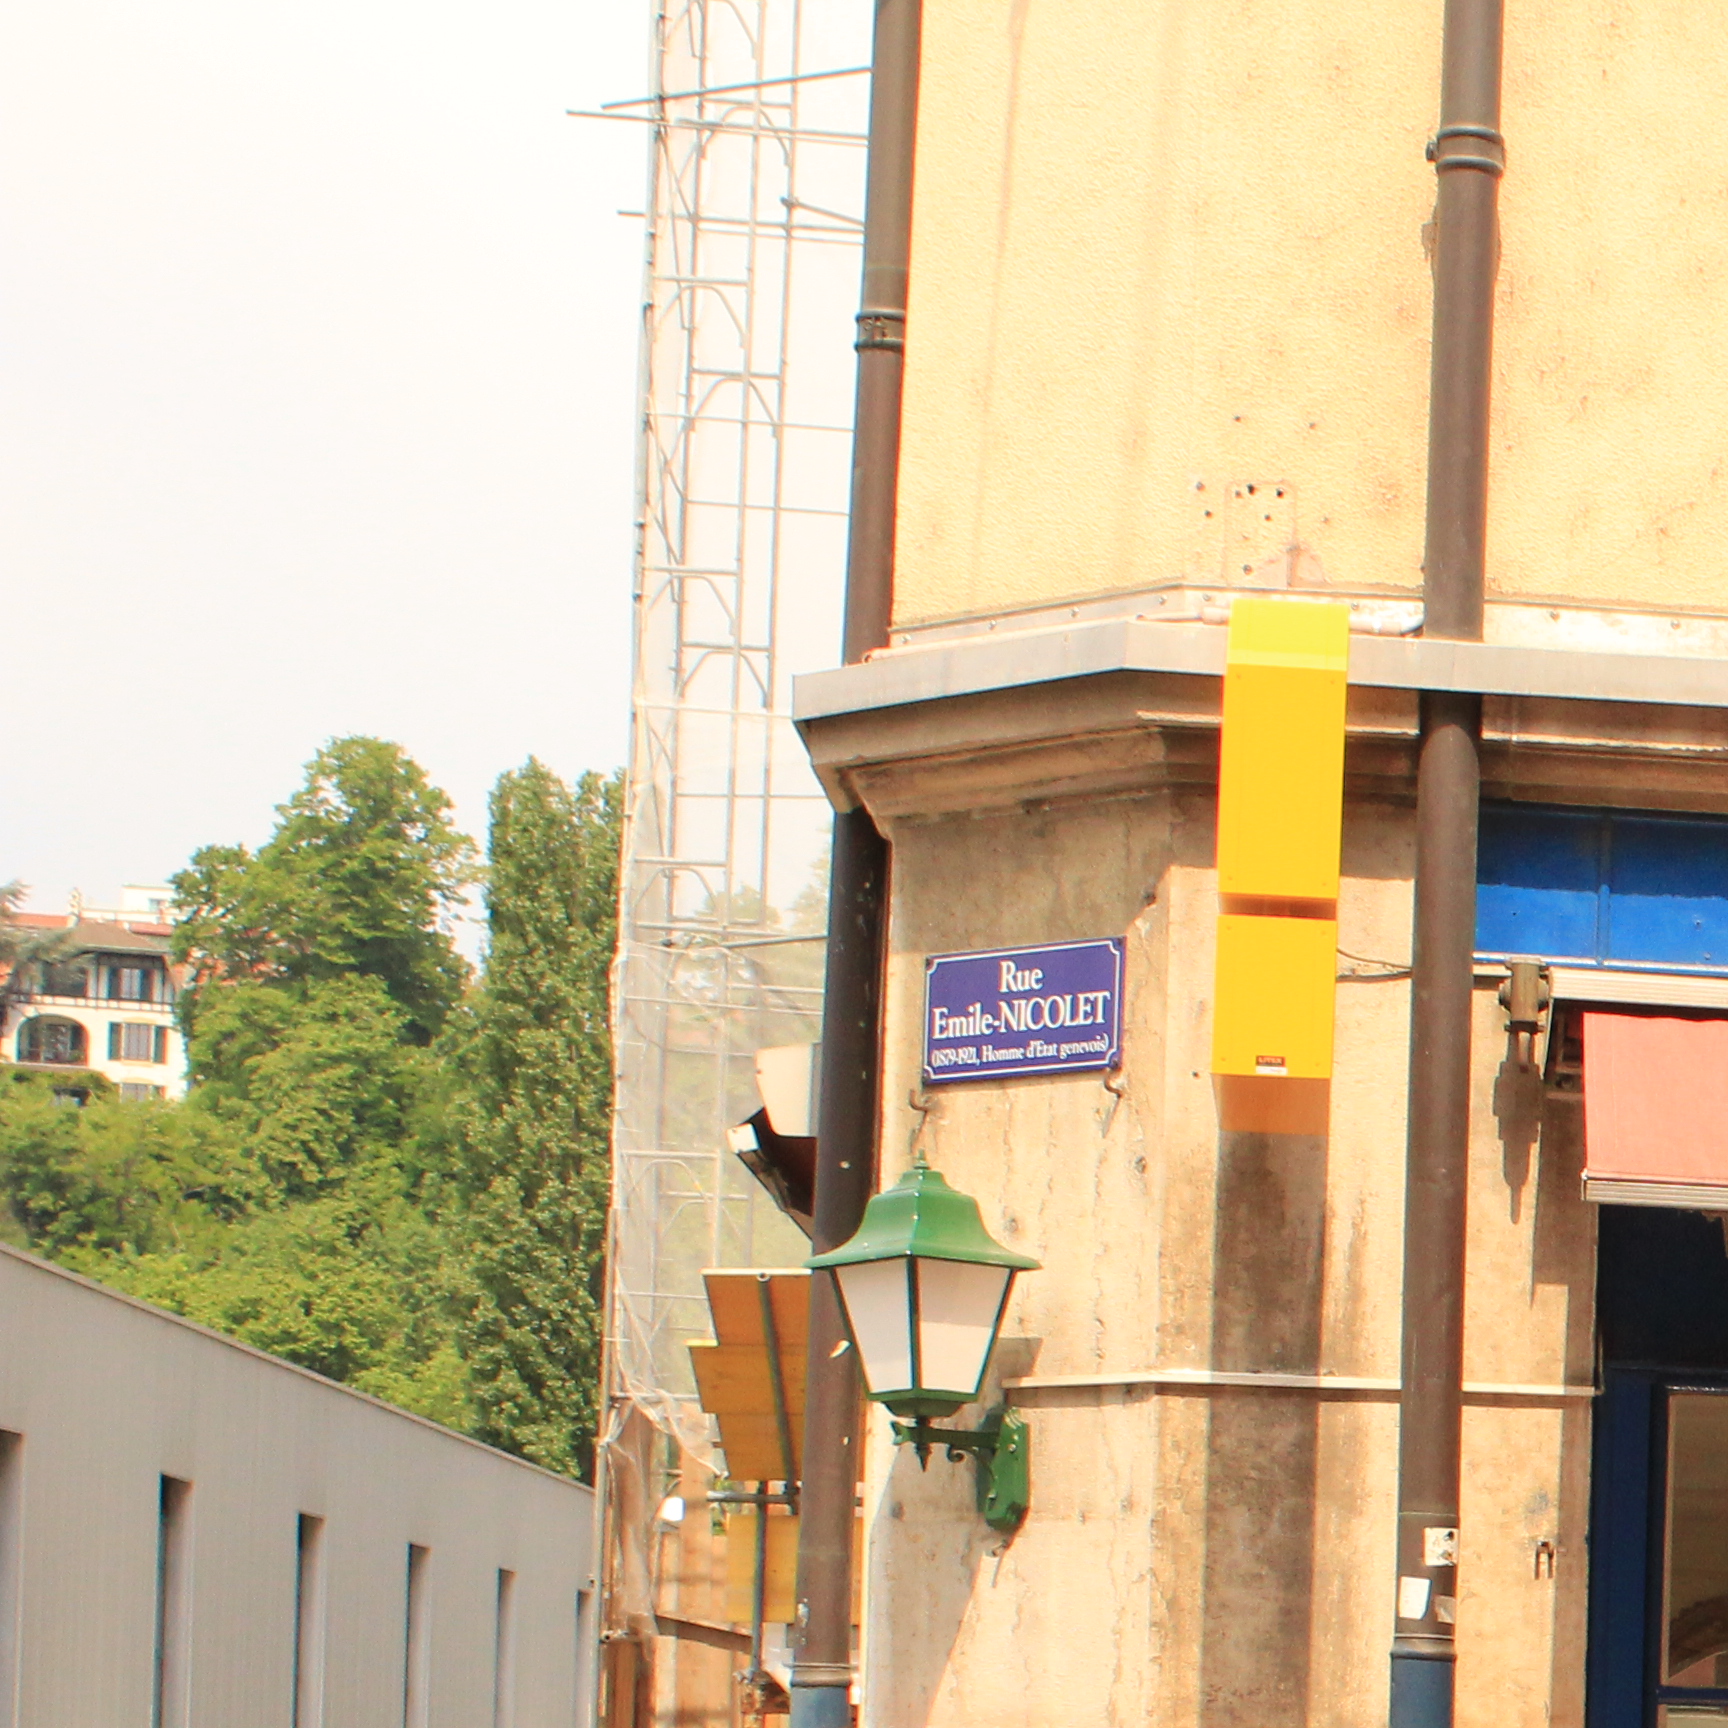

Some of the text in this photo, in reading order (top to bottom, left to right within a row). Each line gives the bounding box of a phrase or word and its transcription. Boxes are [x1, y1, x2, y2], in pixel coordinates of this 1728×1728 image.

[999, 959, 1044, 993] Rue
[931, 991, 1111, 1040] Emile-NICOLET
[982, 1044, 1025, 1063] Homme
[1059, 1033, 1109, 1059] genevois)
